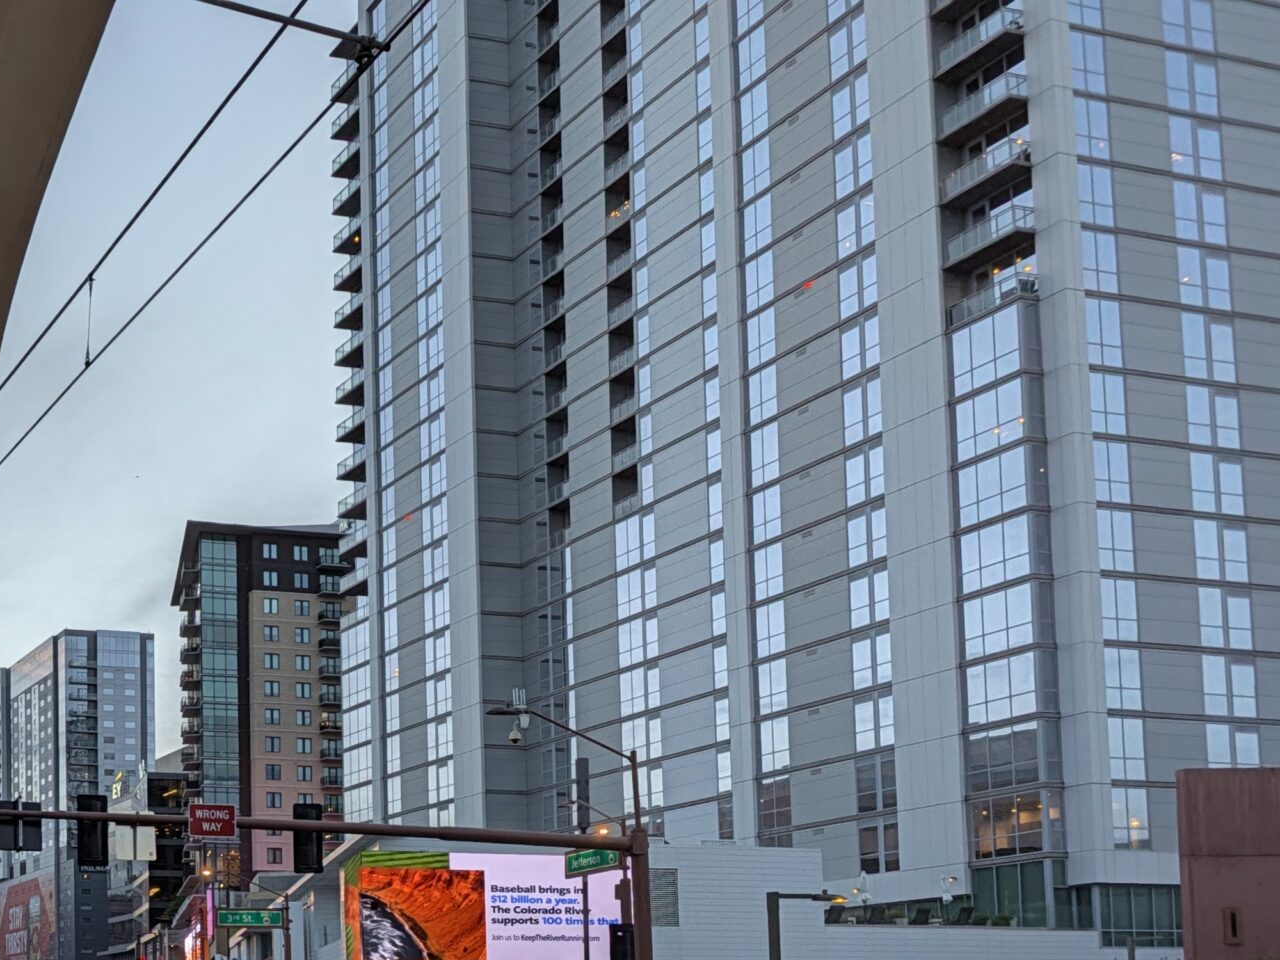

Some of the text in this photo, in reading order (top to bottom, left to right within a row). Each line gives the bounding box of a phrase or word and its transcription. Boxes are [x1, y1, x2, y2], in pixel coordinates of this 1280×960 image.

[112, 782, 122, 800] EY
[195, 809, 230, 820] WRONG
[202, 822, 222, 832] WAY
[571, 855, 601, 869] Jefferson
[490, 884, 536, 893] Baseball
[538, 885, 571, 896] brings
[490, 895, 508, 904] $12
[510, 895, 543, 904] billion
[554, 897, 580, 906] year.
[490, 905, 591, 915] The Colorado Rivr
[241, 914, 255, 922] St.
[491, 917, 619, 926] supports 100 tims that
